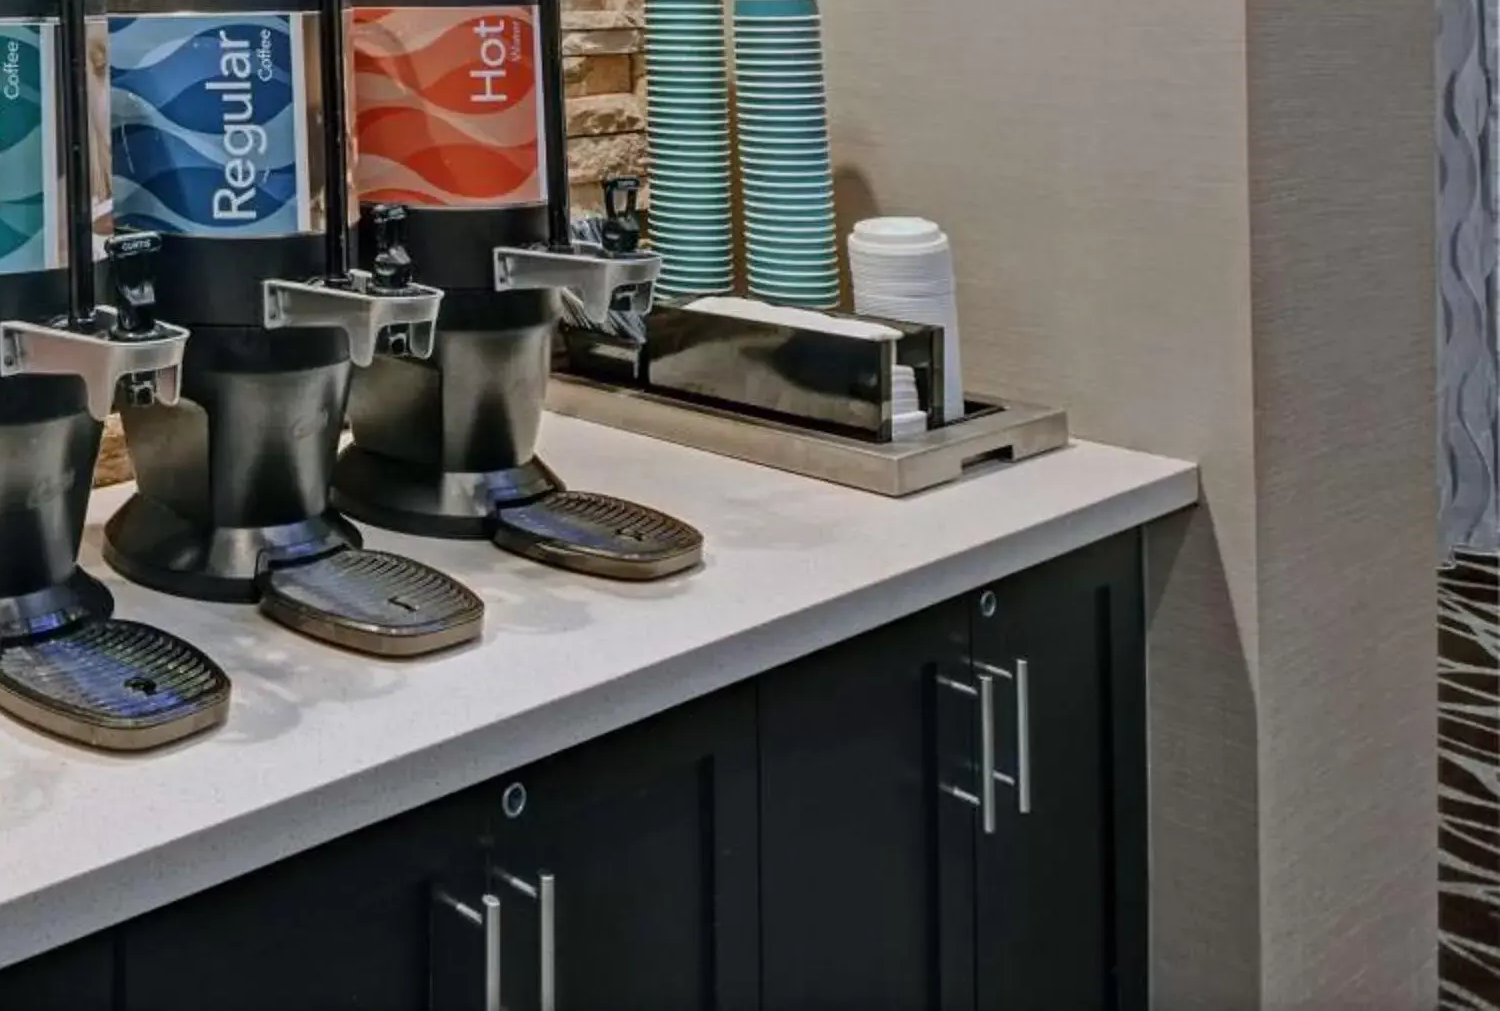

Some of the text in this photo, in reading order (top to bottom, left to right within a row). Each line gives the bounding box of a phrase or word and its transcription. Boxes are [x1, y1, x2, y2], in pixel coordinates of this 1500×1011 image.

[3, 41, 21, 100] Coffee
[256, 28, 273, 83] Coffee
[469, 19, 508, 102] Hot
[204, 29, 267, 220] Regular
